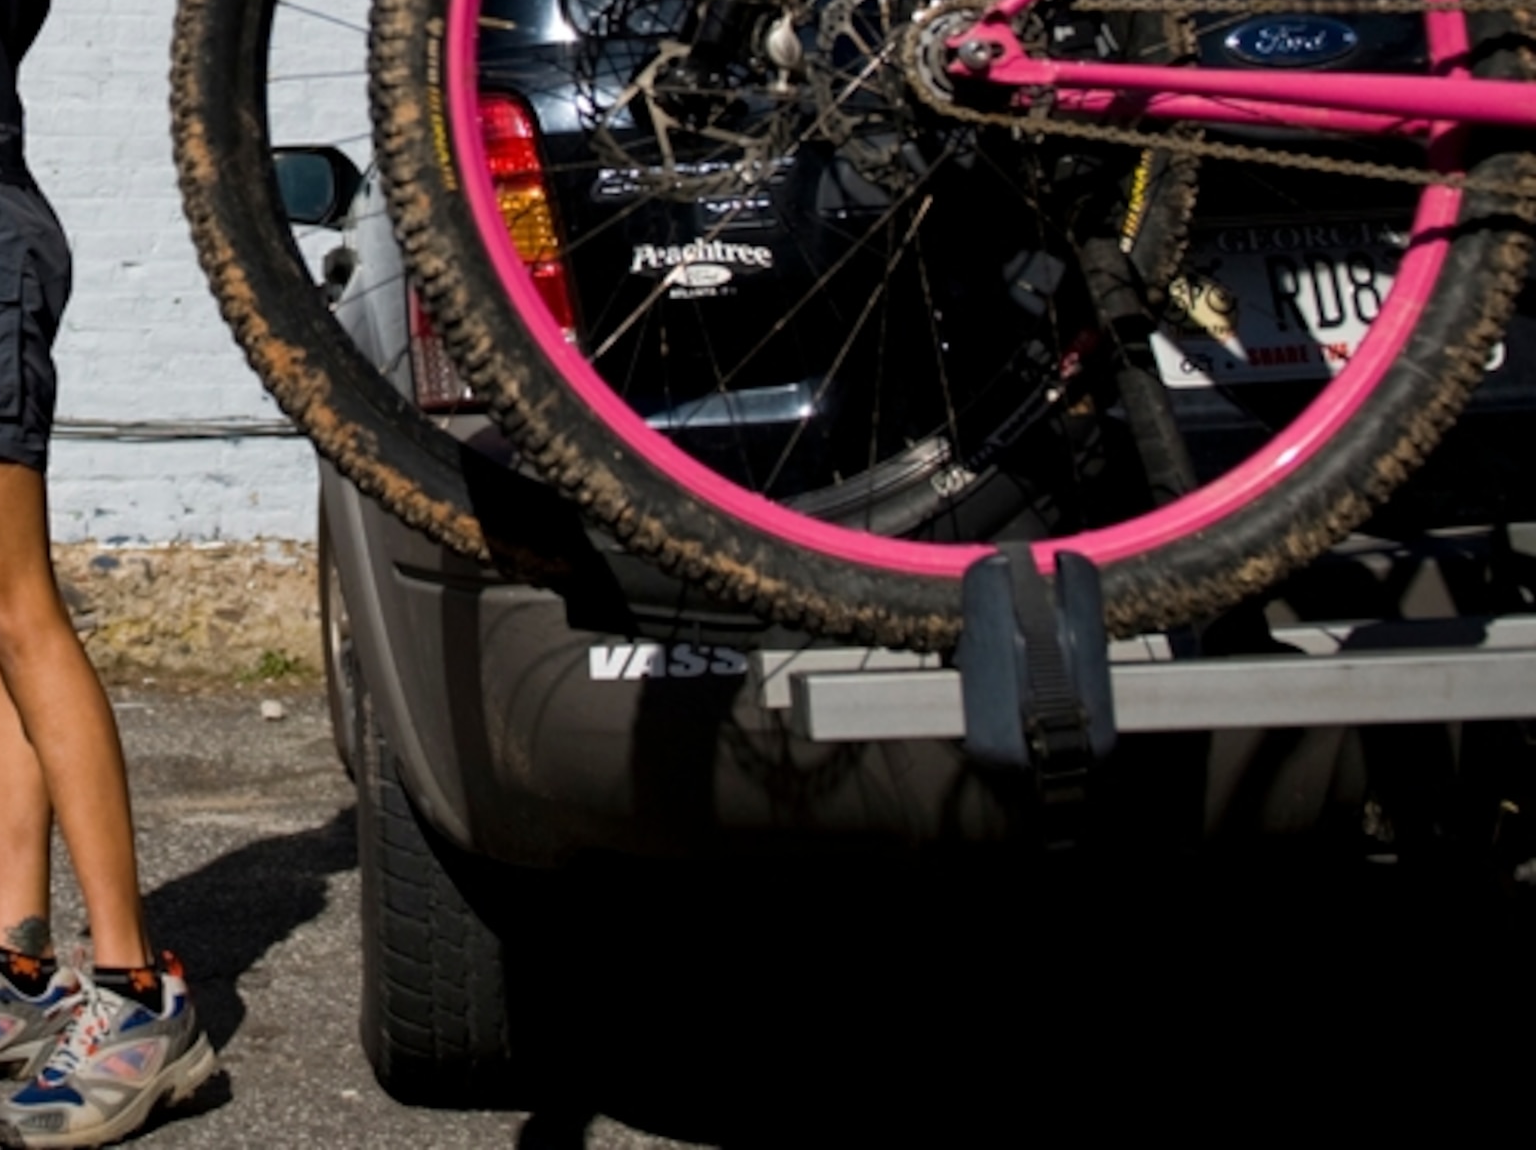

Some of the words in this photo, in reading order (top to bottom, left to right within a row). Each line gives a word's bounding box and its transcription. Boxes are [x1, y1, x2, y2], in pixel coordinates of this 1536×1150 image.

[1255, 25, 1326, 54] Ford
[1217, 222, 1410, 250] GEORGIA
[629, 237, 773, 274] Peachtree
[1266, 252, 1408, 332] RD8
